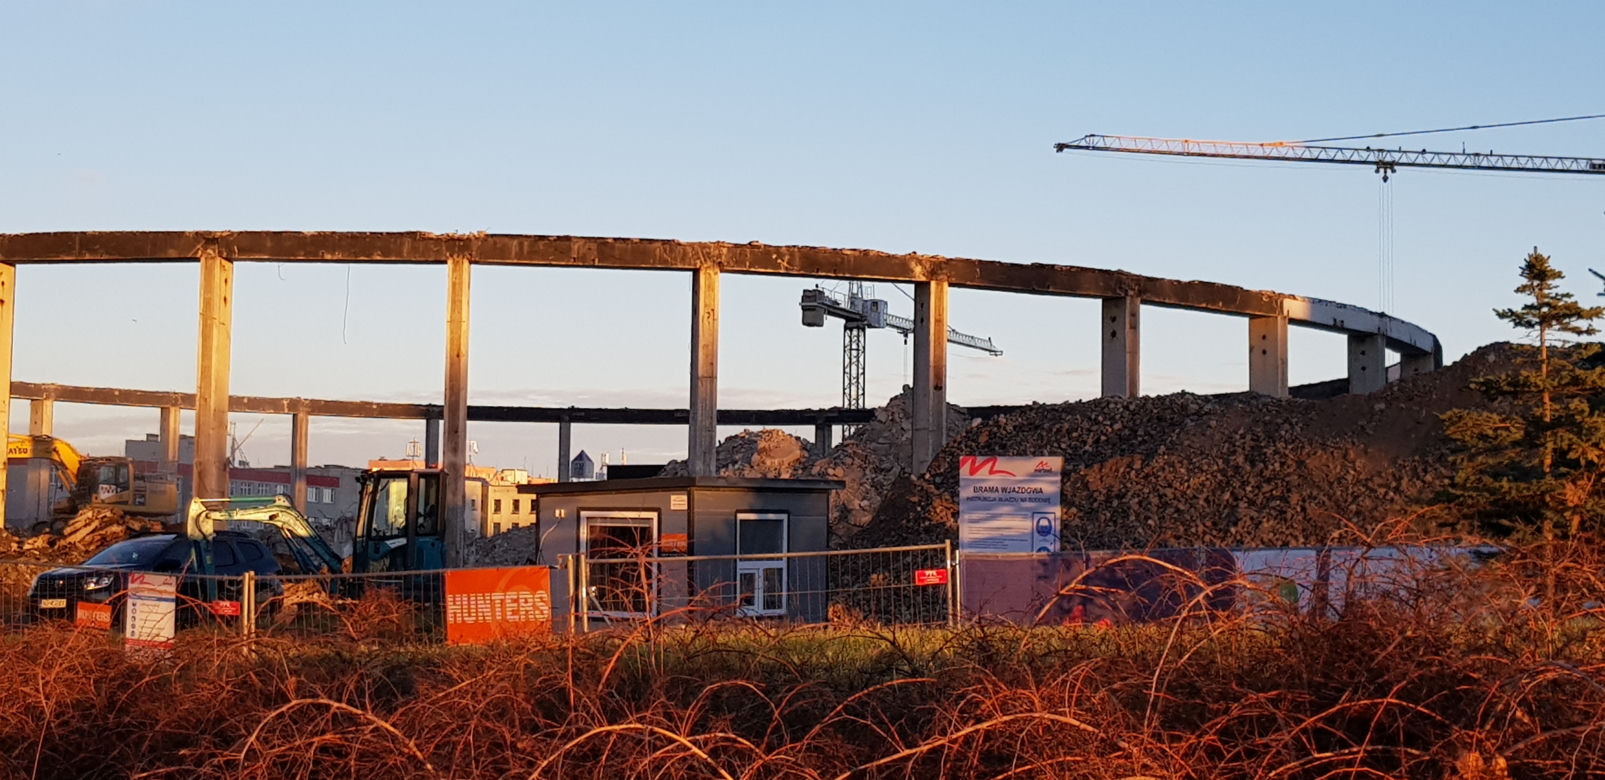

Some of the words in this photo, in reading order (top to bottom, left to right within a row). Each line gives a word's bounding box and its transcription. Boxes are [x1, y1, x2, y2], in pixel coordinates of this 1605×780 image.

[8, 447, 28, 455] ATSU
[973, 485, 999, 494] BRAMA
[1001, 486, 1044, 494] WJAZDOWA
[447, 590, 549, 624] HUNTERS
